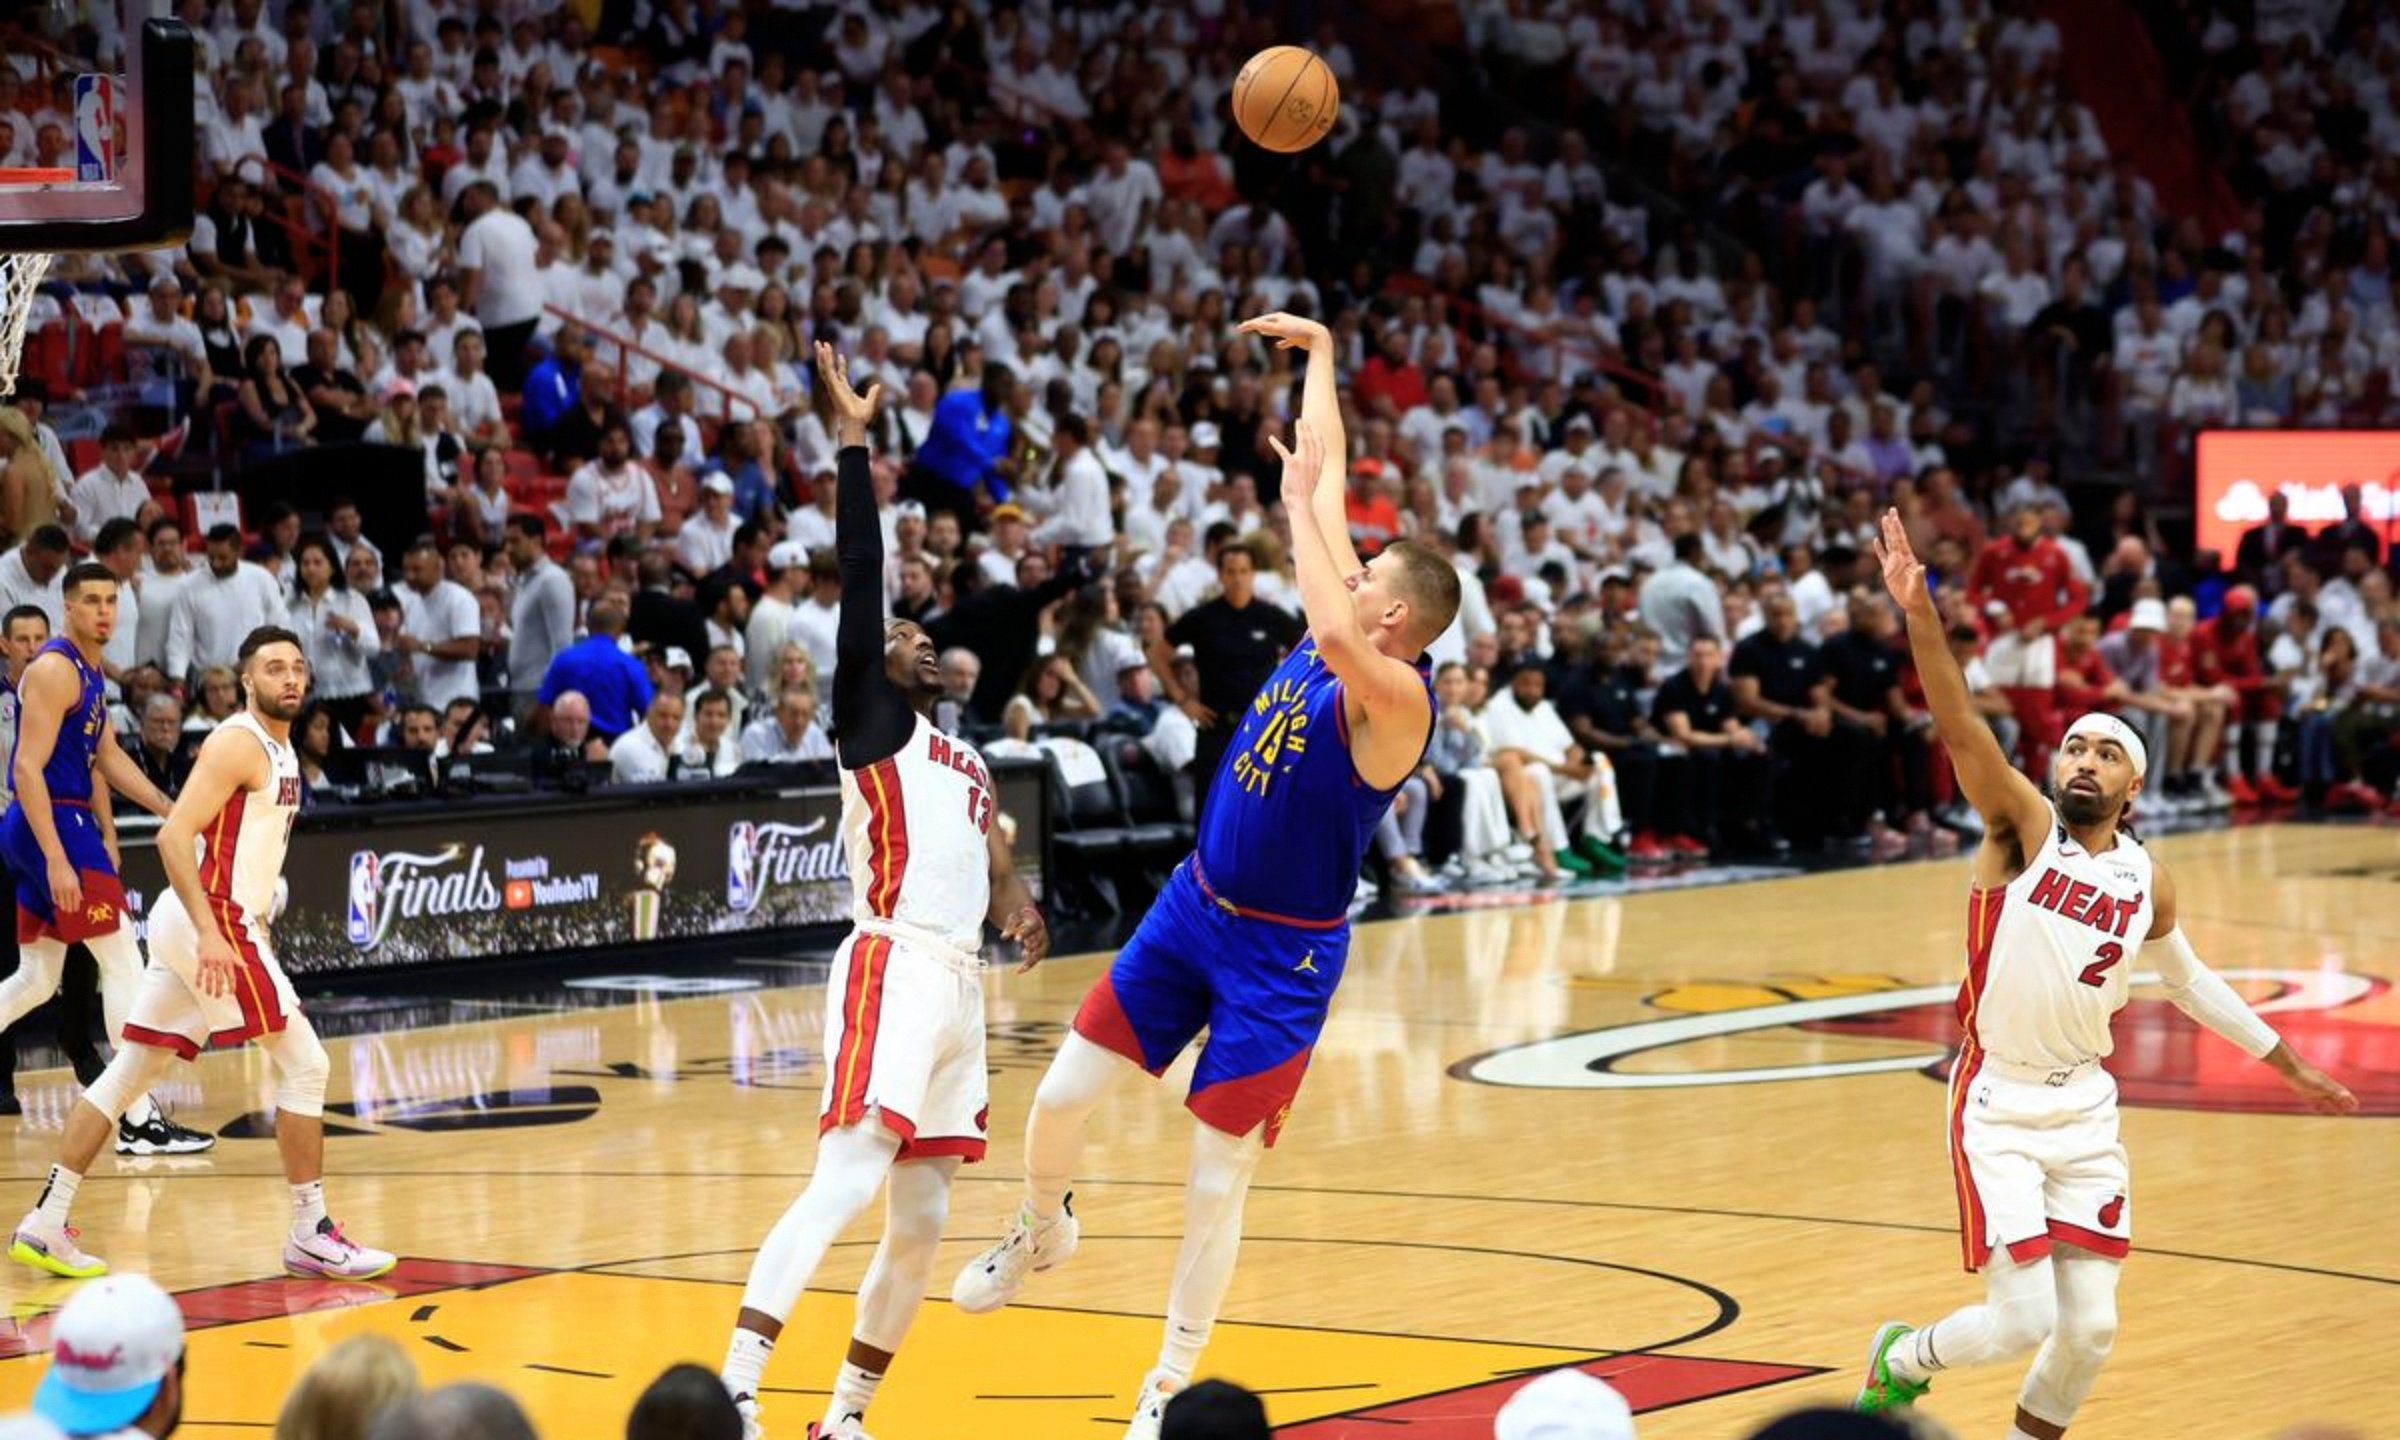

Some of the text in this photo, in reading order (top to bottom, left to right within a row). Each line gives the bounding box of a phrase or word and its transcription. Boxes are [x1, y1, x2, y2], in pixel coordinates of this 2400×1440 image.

[1254, 710, 1288, 765] 15
[1233, 751, 1271, 797] CITY
[967, 786, 991, 835] 13
[363, 843, 500, 951] Finals
[2028, 867, 2144, 938] HEAT
[2077, 941, 2123, 988] 2
